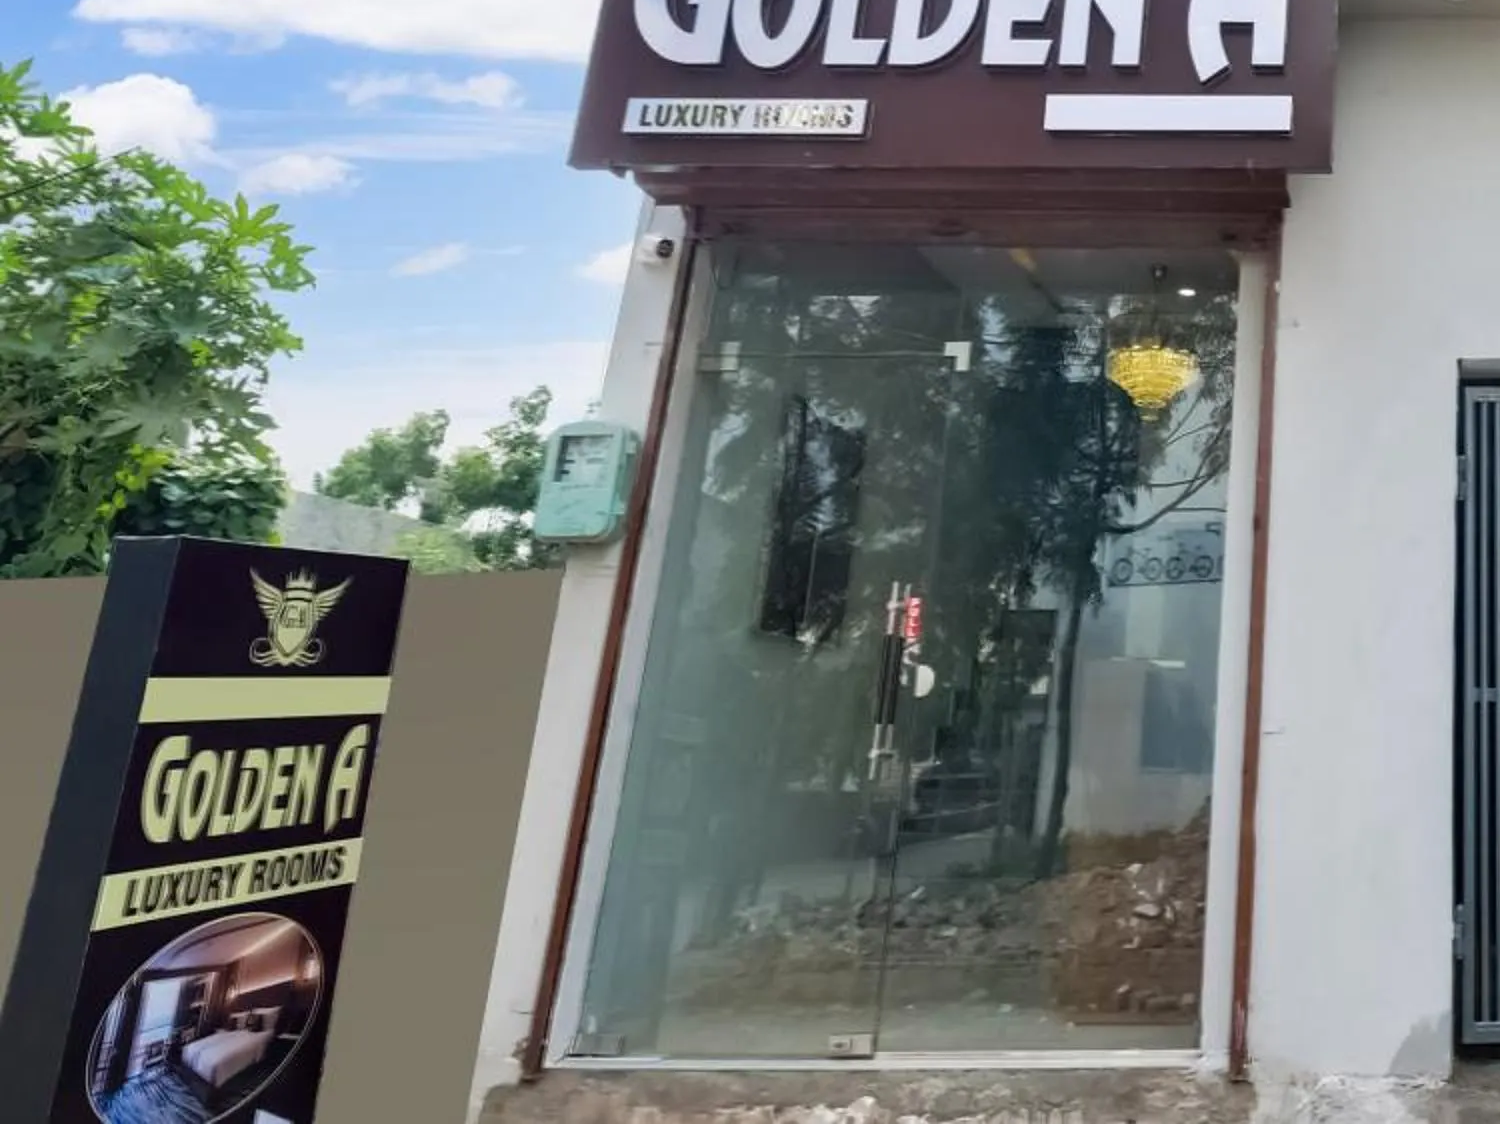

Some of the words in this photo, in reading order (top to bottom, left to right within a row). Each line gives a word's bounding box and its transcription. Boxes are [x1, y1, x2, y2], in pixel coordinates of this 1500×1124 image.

[639, 104, 745, 128] LUXURY
[140, 734, 327, 844] GOLDEN
[323, 723, 371, 835] A
[121, 861, 246, 918] LUXURY
[247, 845, 348, 894] ROOMS
